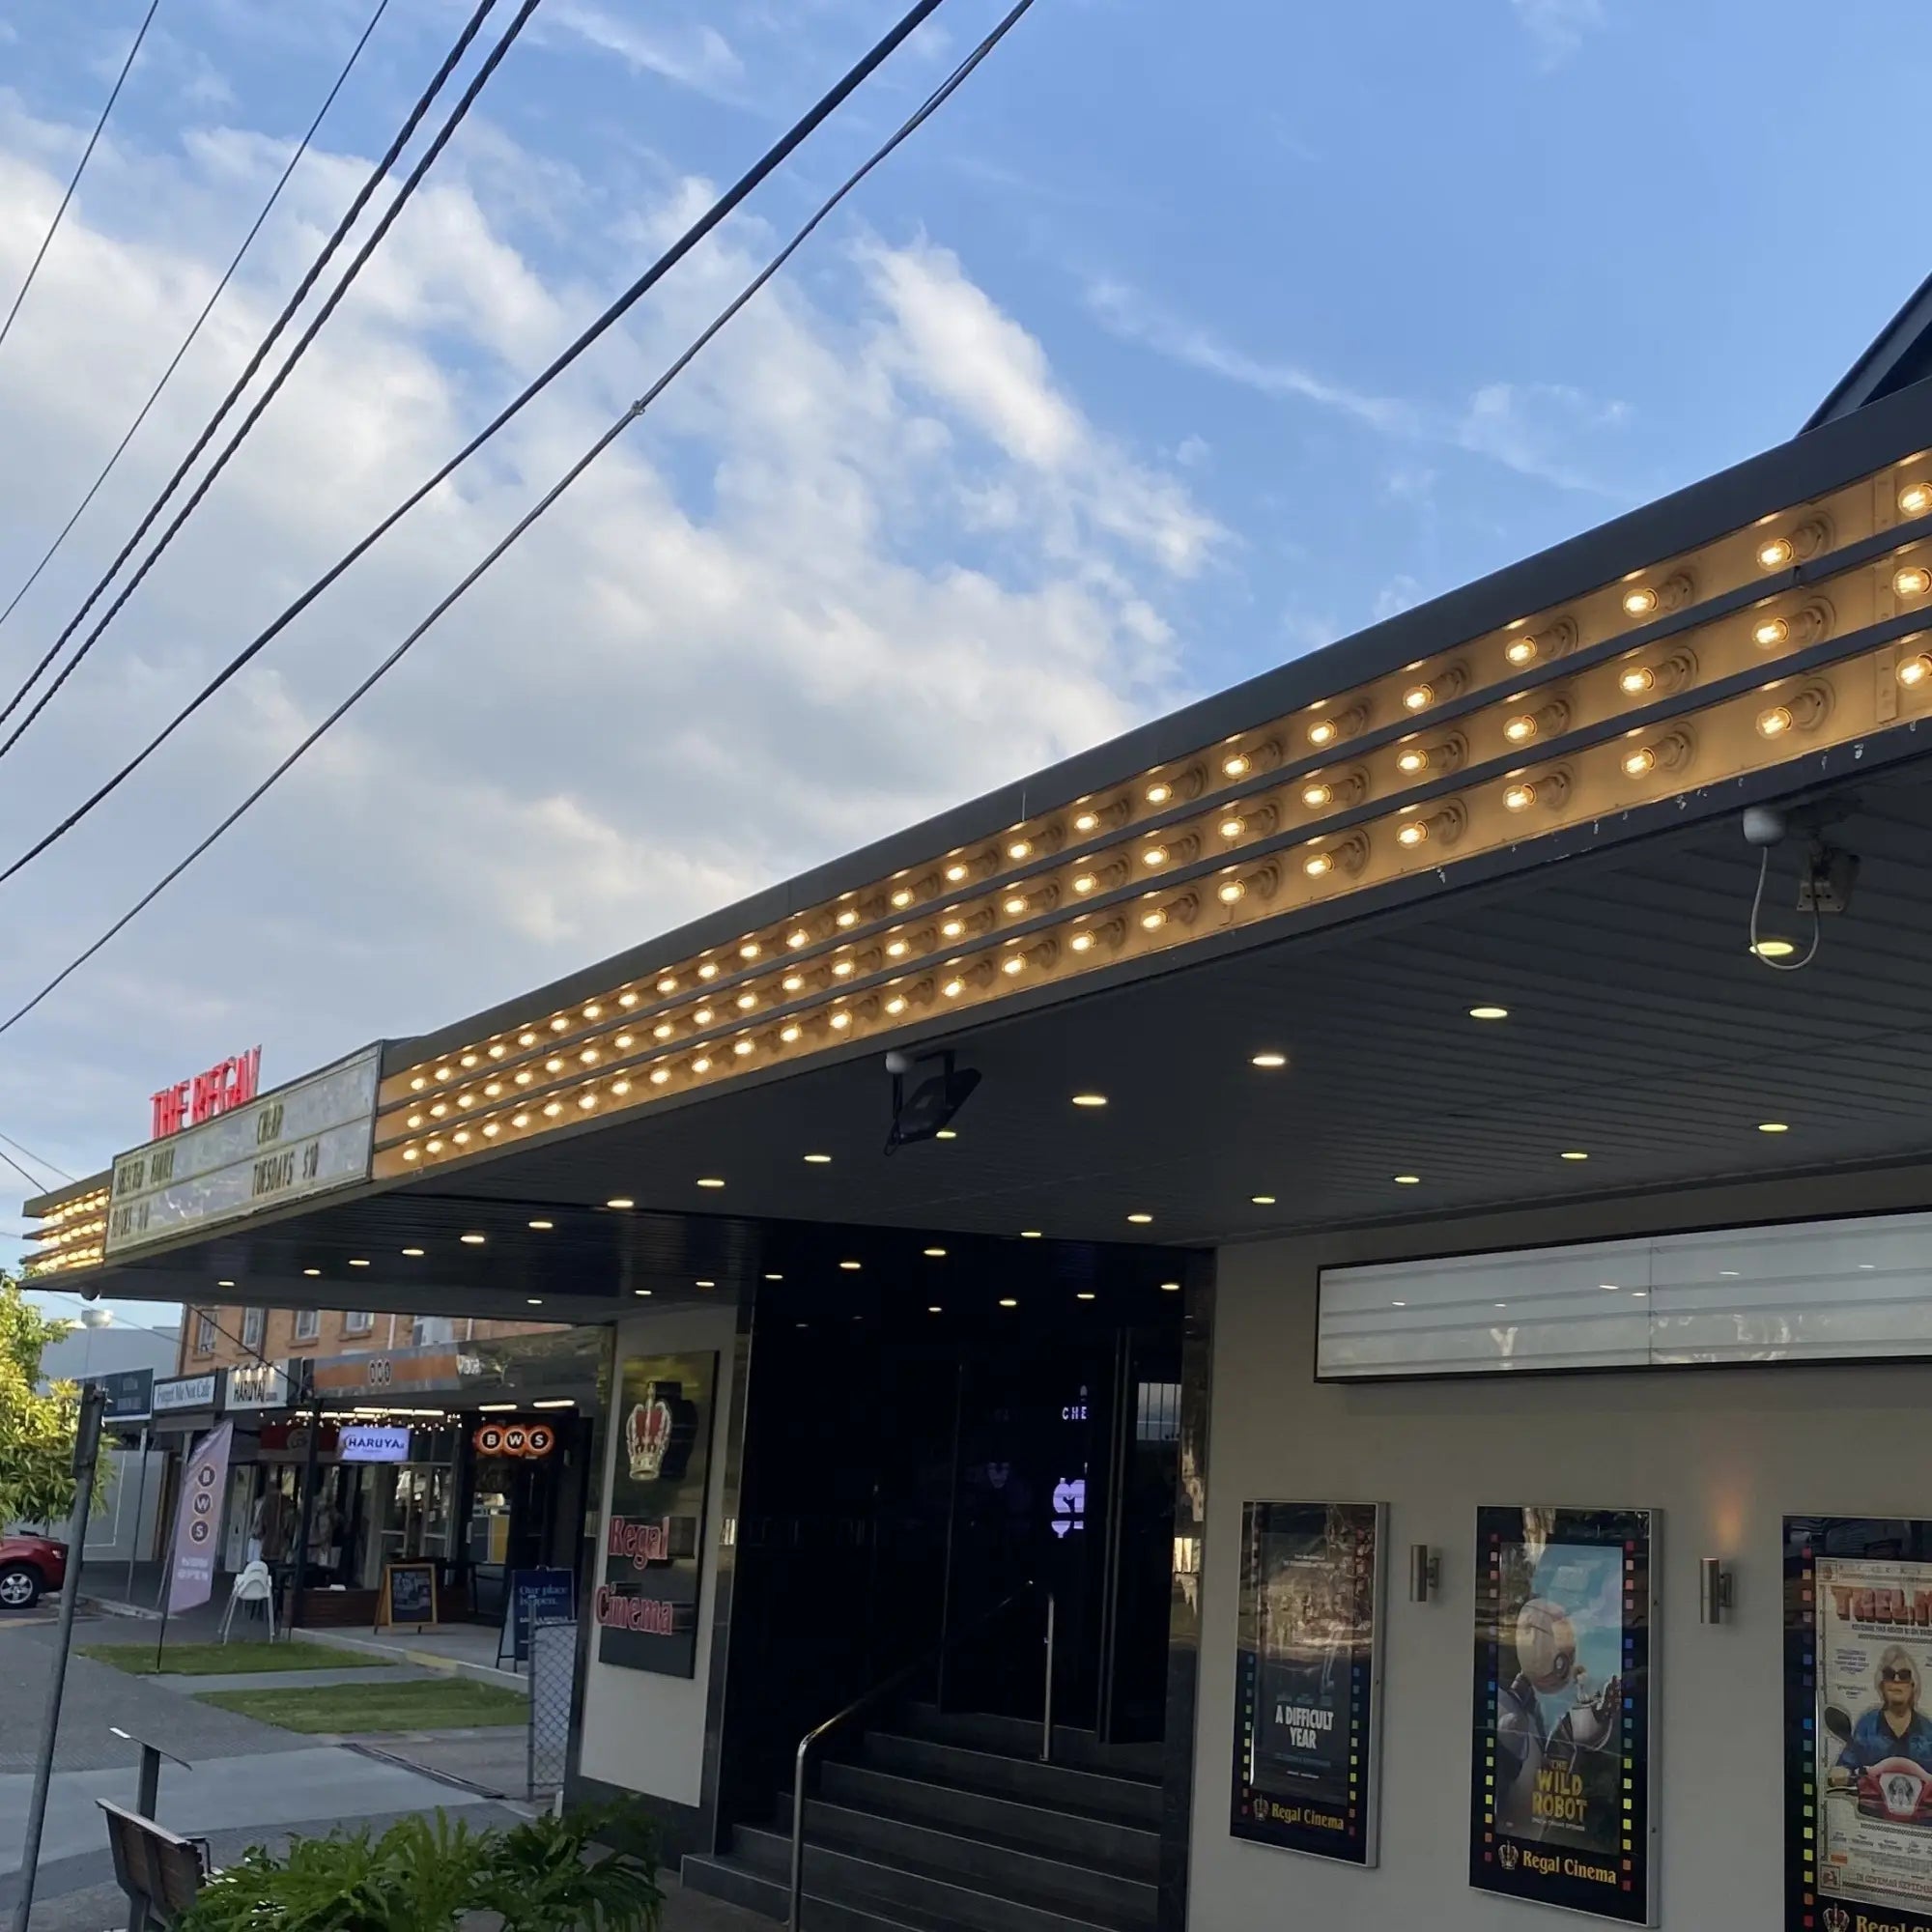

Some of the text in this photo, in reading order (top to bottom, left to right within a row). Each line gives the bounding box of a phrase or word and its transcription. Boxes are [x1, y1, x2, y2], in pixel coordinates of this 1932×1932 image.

[149, 1043, 262, 1142] THE REGAL
[252, 1151, 296, 1197] TUESDAYS
[349, 1437, 400, 1449] HARUYA
[484, 1433, 547, 1447] BWS
[194, 1467, 213, 1540] BWS
[608, 1516, 670, 1571] Regal
[595, 1581, 673, 1635] Cinema
[1275, 1705, 1334, 1730] A DIFFICULT
[1290, 1726, 1317, 1749] YEAR
[1537, 1770, 1583, 1797] WILD
[1271, 1803, 1344, 1831] Regal Cinema
[1532, 1792, 1587, 1823] ROBOT
[1522, 1850, 1617, 1885] Regal Cinema
